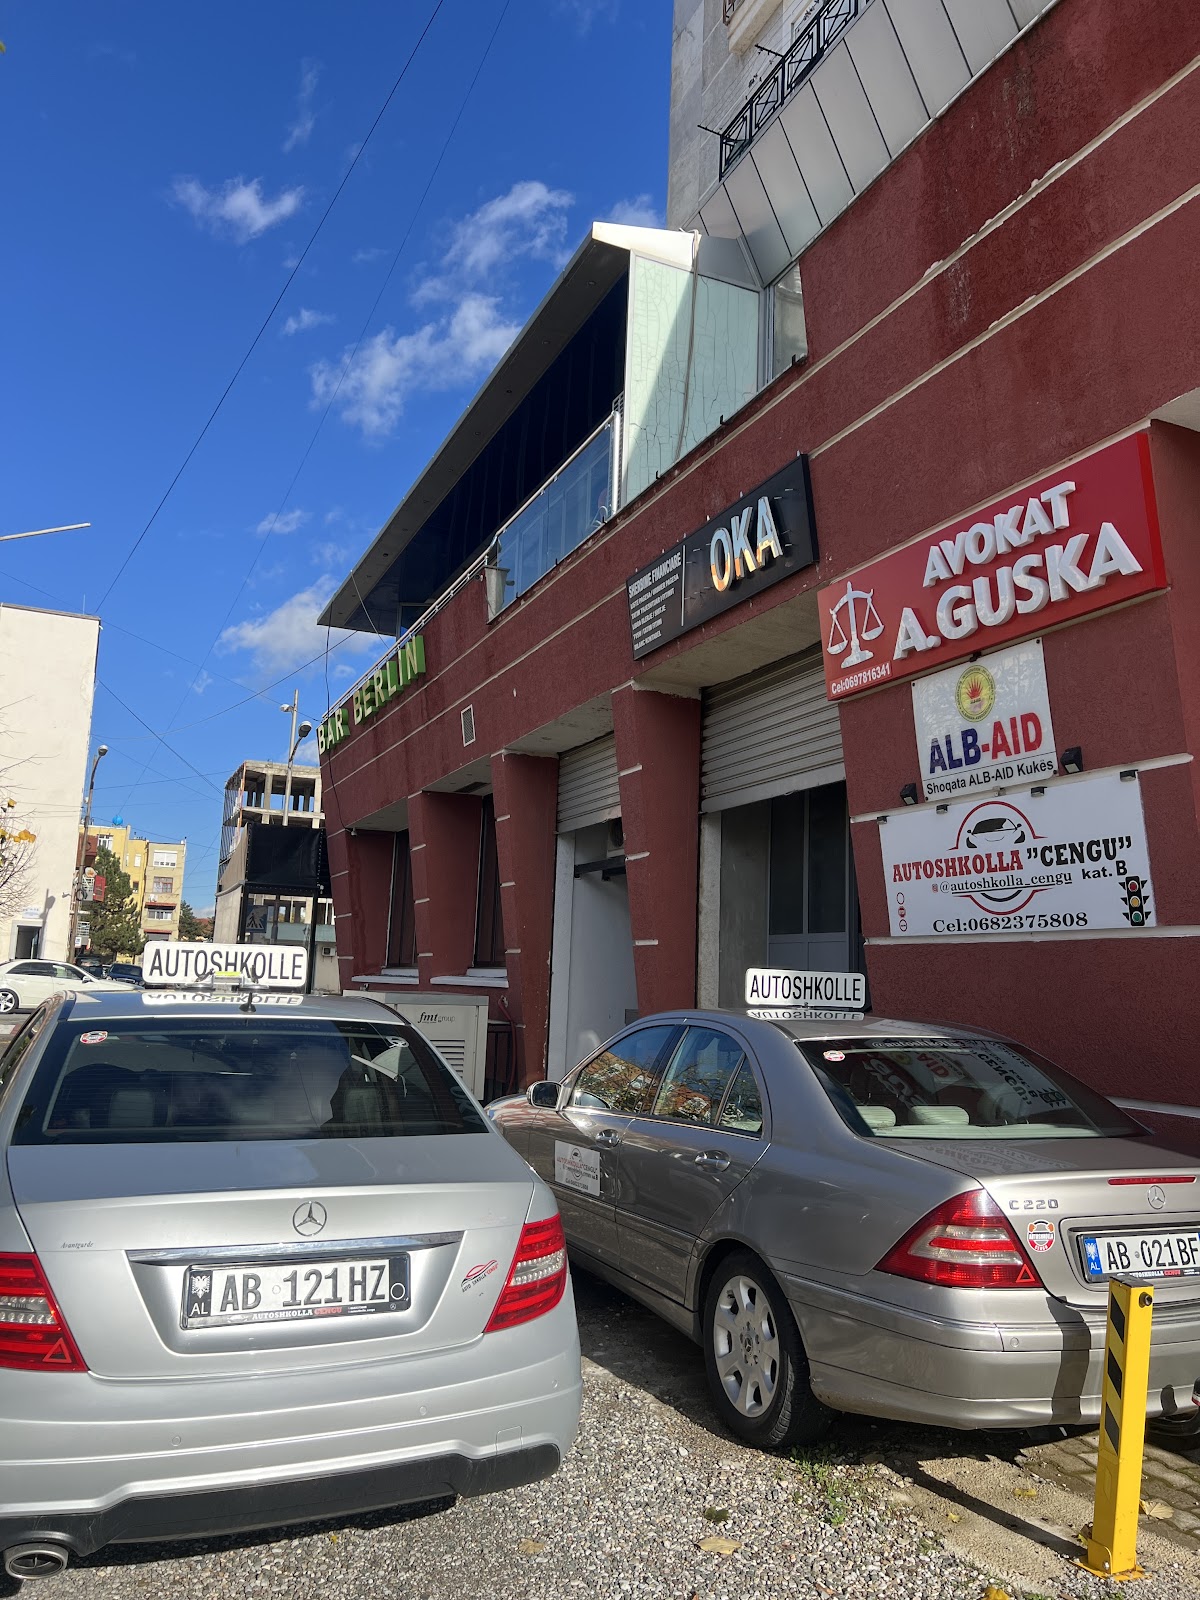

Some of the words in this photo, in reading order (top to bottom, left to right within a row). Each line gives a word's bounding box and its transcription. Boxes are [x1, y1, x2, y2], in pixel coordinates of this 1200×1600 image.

[710, 496, 783, 592] OKA
[923, 481, 1076, 587] AVOKAT
[893, 522, 1143, 660] A.GUSKA
[831, 662, 890, 695] Cel:0697816341
[318, 708, 350, 755] BAR
[353, 634, 426, 726] BERLIN
[929, 712, 1043, 774] ALB-AID
[926, 779, 967, 795] Shoqata
[969, 766, 1014, 787] ALB-AID
[1017, 759, 1054, 777] Kukës
[893, 849, 1023, 882] AUTOSHKOLLA
[1081, 867, 1113, 880] kat.
[1116, 860, 1128, 876] B
[940, 871, 1072, 893] @autoshkolla_cengu
[933, 912, 1088, 932] Cel:0682375808
[149, 948, 304, 981] AUTOSHKOLLE
[750, 975, 861, 1002] AUTOSHKOLLE
[417, 1011, 438, 1024] fmt
[1009, 1200, 1020, 1210] C
[1023, 1199, 1059, 1210] 220
[1090, 1262, 1100, 1271] AL
[1106, 1241, 1130, 1271] AB
[220, 1273, 262, 1312] AB
[190, 1303, 208, 1316] AL
[252, 1308, 313, 1320] AUTOSHKOLLA
